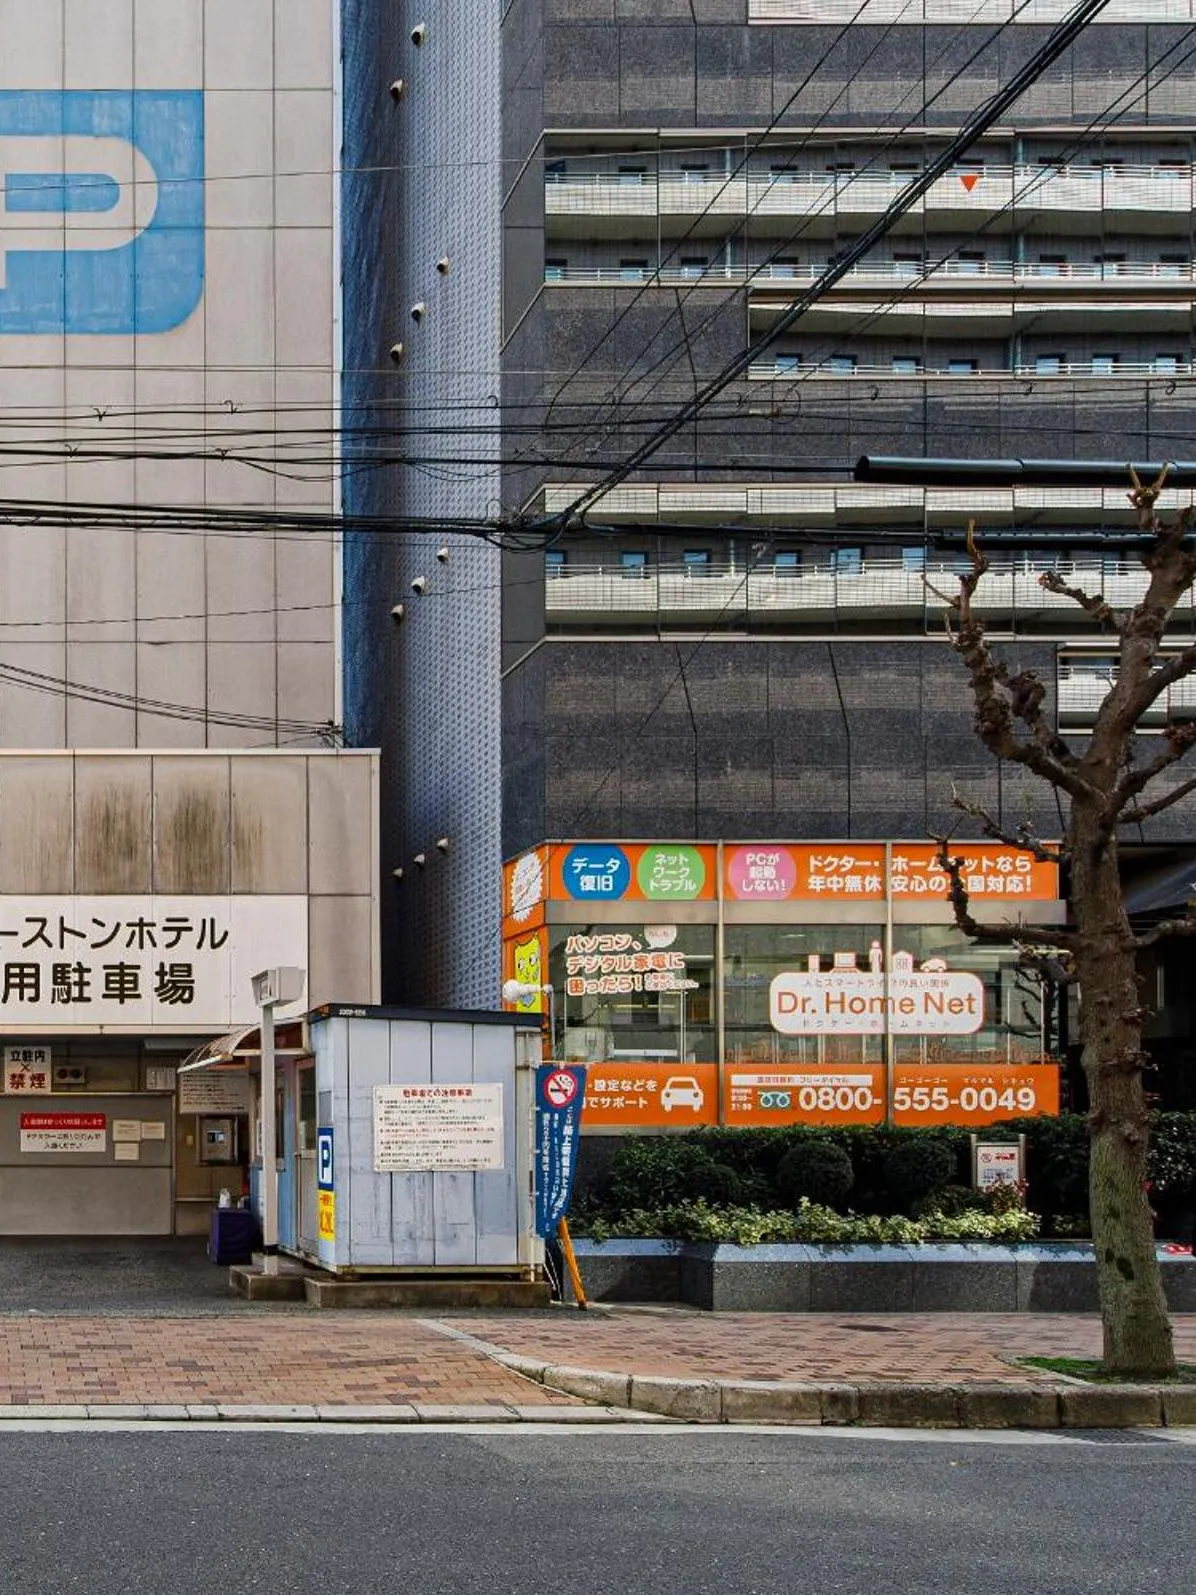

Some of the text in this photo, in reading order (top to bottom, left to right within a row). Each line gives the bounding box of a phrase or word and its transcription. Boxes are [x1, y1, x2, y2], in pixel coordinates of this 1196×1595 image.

[571, 857, 621, 874] データ
[655, 853, 689, 865] ネット
[745, 852, 780, 865] PCが
[653, 866, 690, 878] ワーク
[579, 875, 613, 891] 復旧
[649, 879, 697, 891] トラブル
[807, 874, 882, 893] 年中無休
[777, 992, 976, 1014] Dr. Home Net
[9, 1073, 46, 1090] 禁煙
[318, 1135, 332, 1184] P
